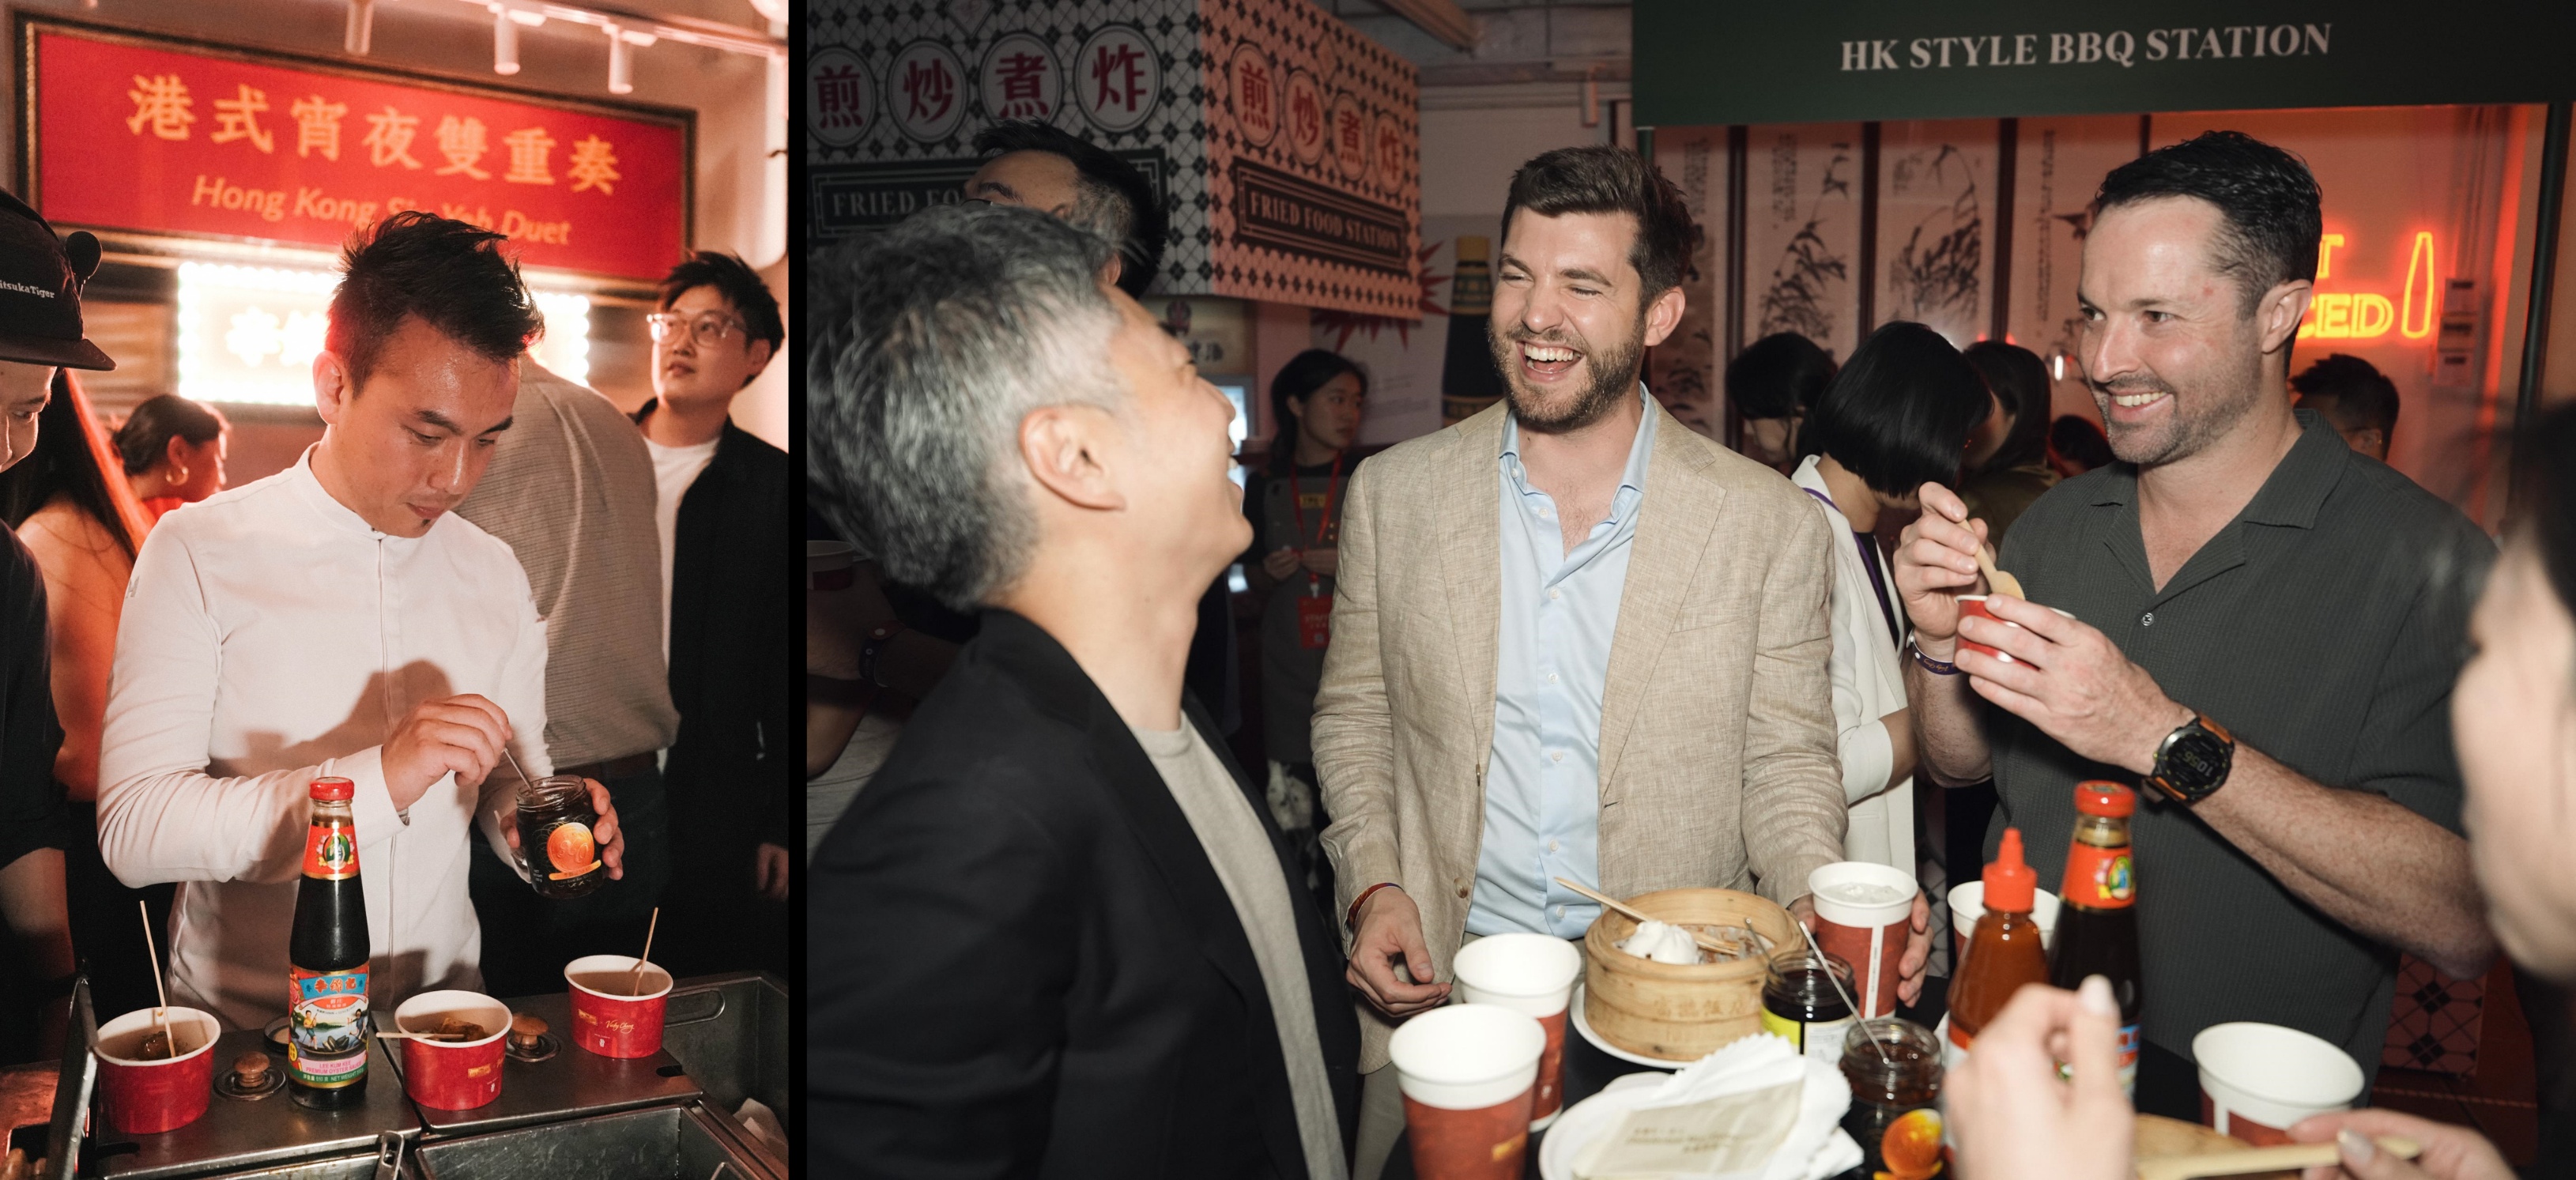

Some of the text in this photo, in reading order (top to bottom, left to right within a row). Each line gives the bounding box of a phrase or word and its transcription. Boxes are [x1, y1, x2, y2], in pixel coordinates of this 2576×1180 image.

[1841, 23, 2332, 70] HK STYLE BBQ STATION
[813, 43, 1148, 130] 煎炒煮炸
[1239, 60, 1399, 181] 煎炒煮炸
[126, 74, 621, 195] 港式宵夜雙重奏
[191, 175, 287, 222] Hong
[294, 187, 379, 228] Kong
[500, 209, 572, 246] Duet
[833, 190, 915, 217] FRIED
[1250, 190, 1398, 250] FRIED FOOD STATION
